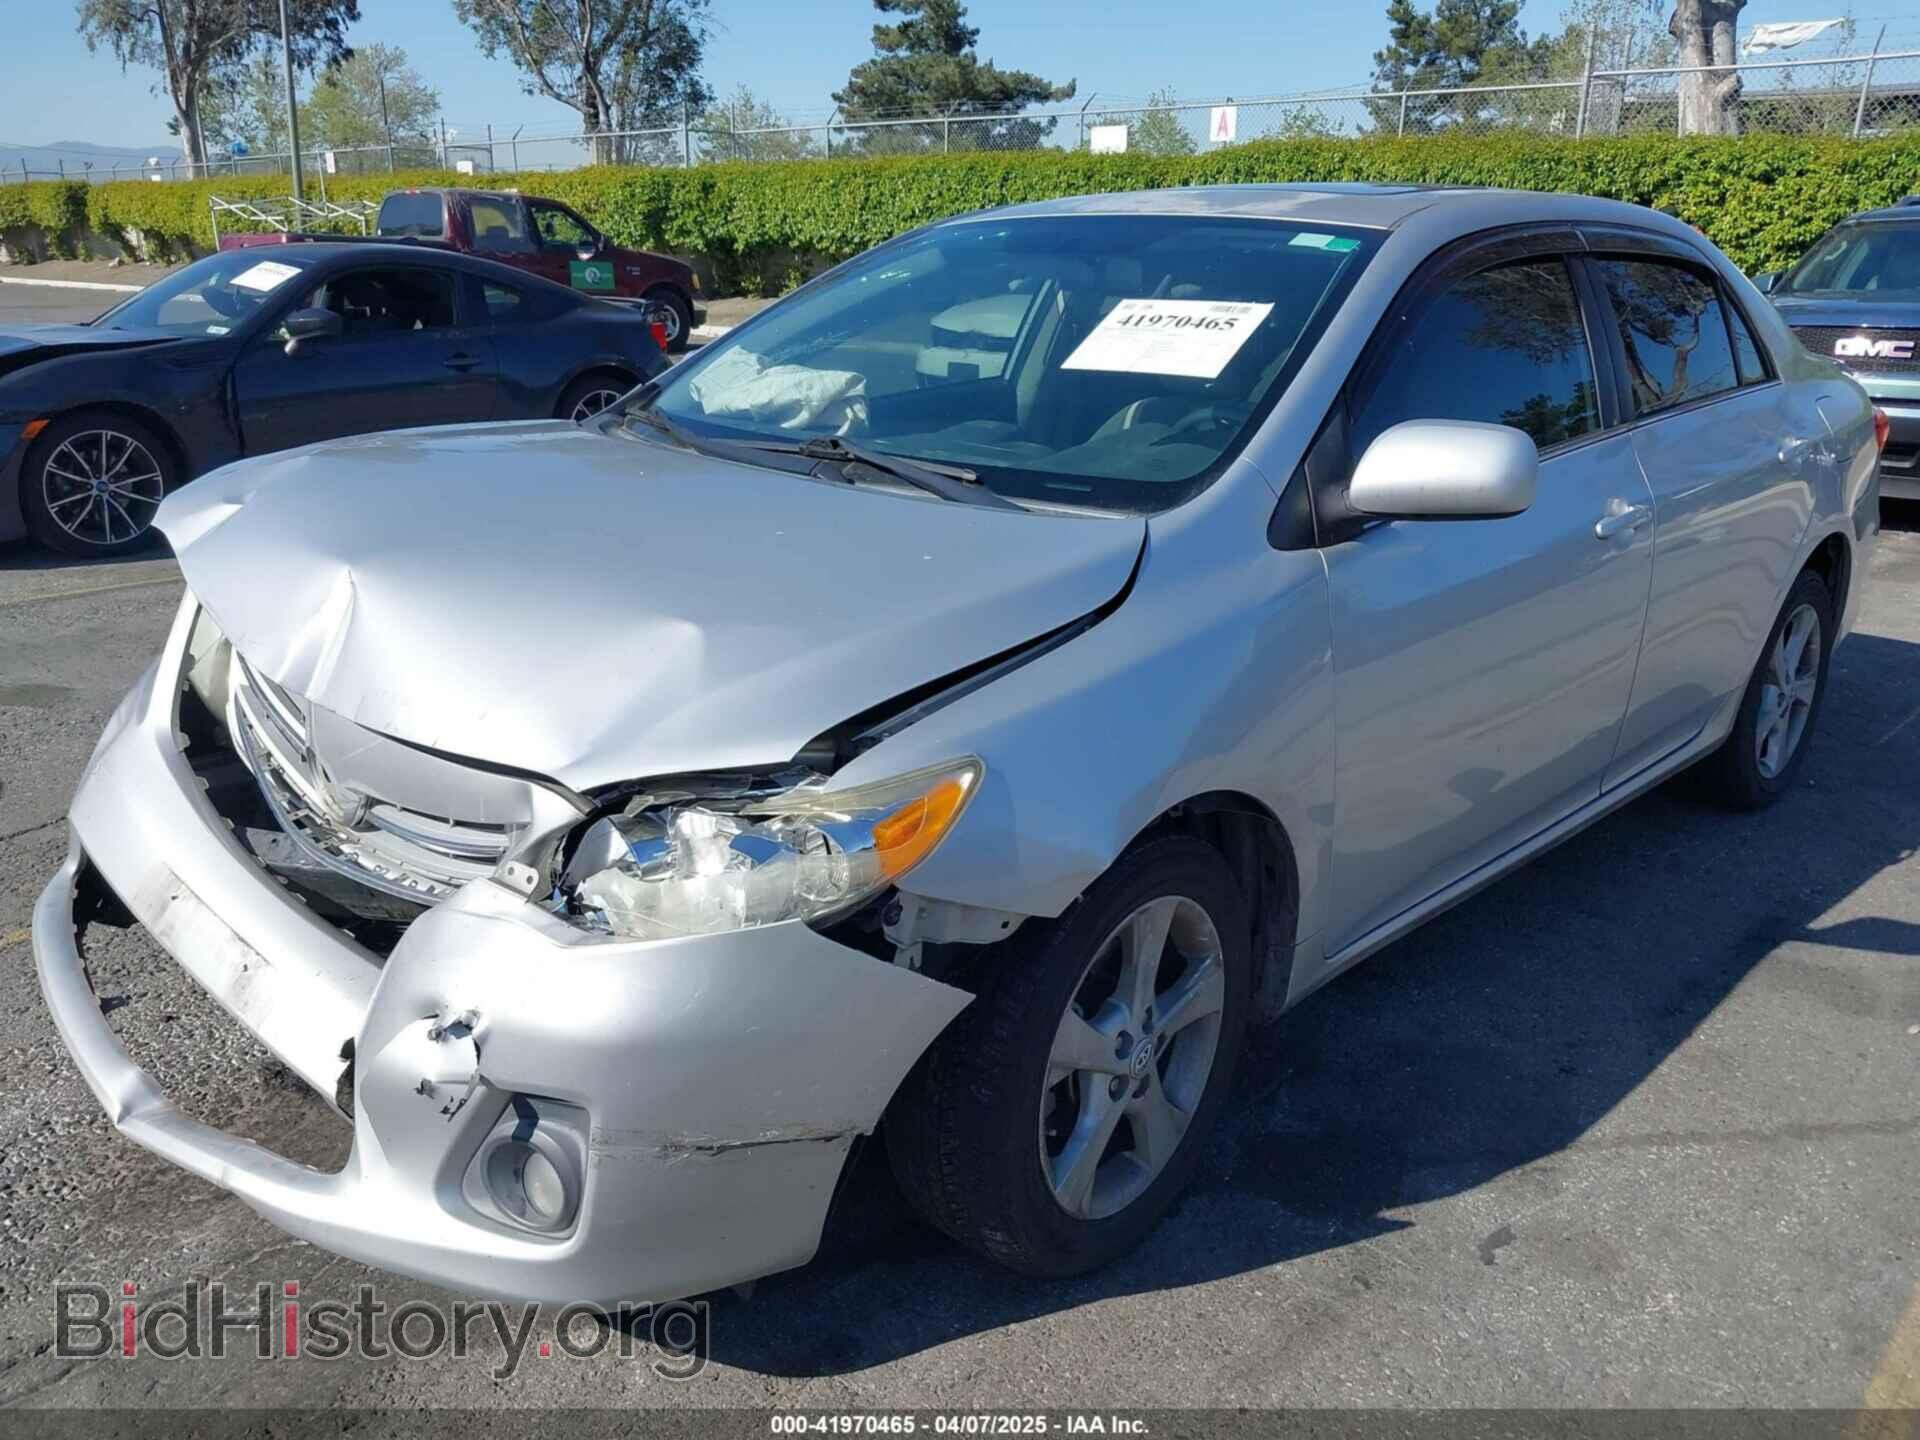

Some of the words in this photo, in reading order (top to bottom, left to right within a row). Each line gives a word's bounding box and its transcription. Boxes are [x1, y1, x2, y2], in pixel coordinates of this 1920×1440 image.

[1217, 110, 1229, 137] A
[1117, 314, 1239, 331] 41970465
[1834, 336, 1915, 358] GMC
